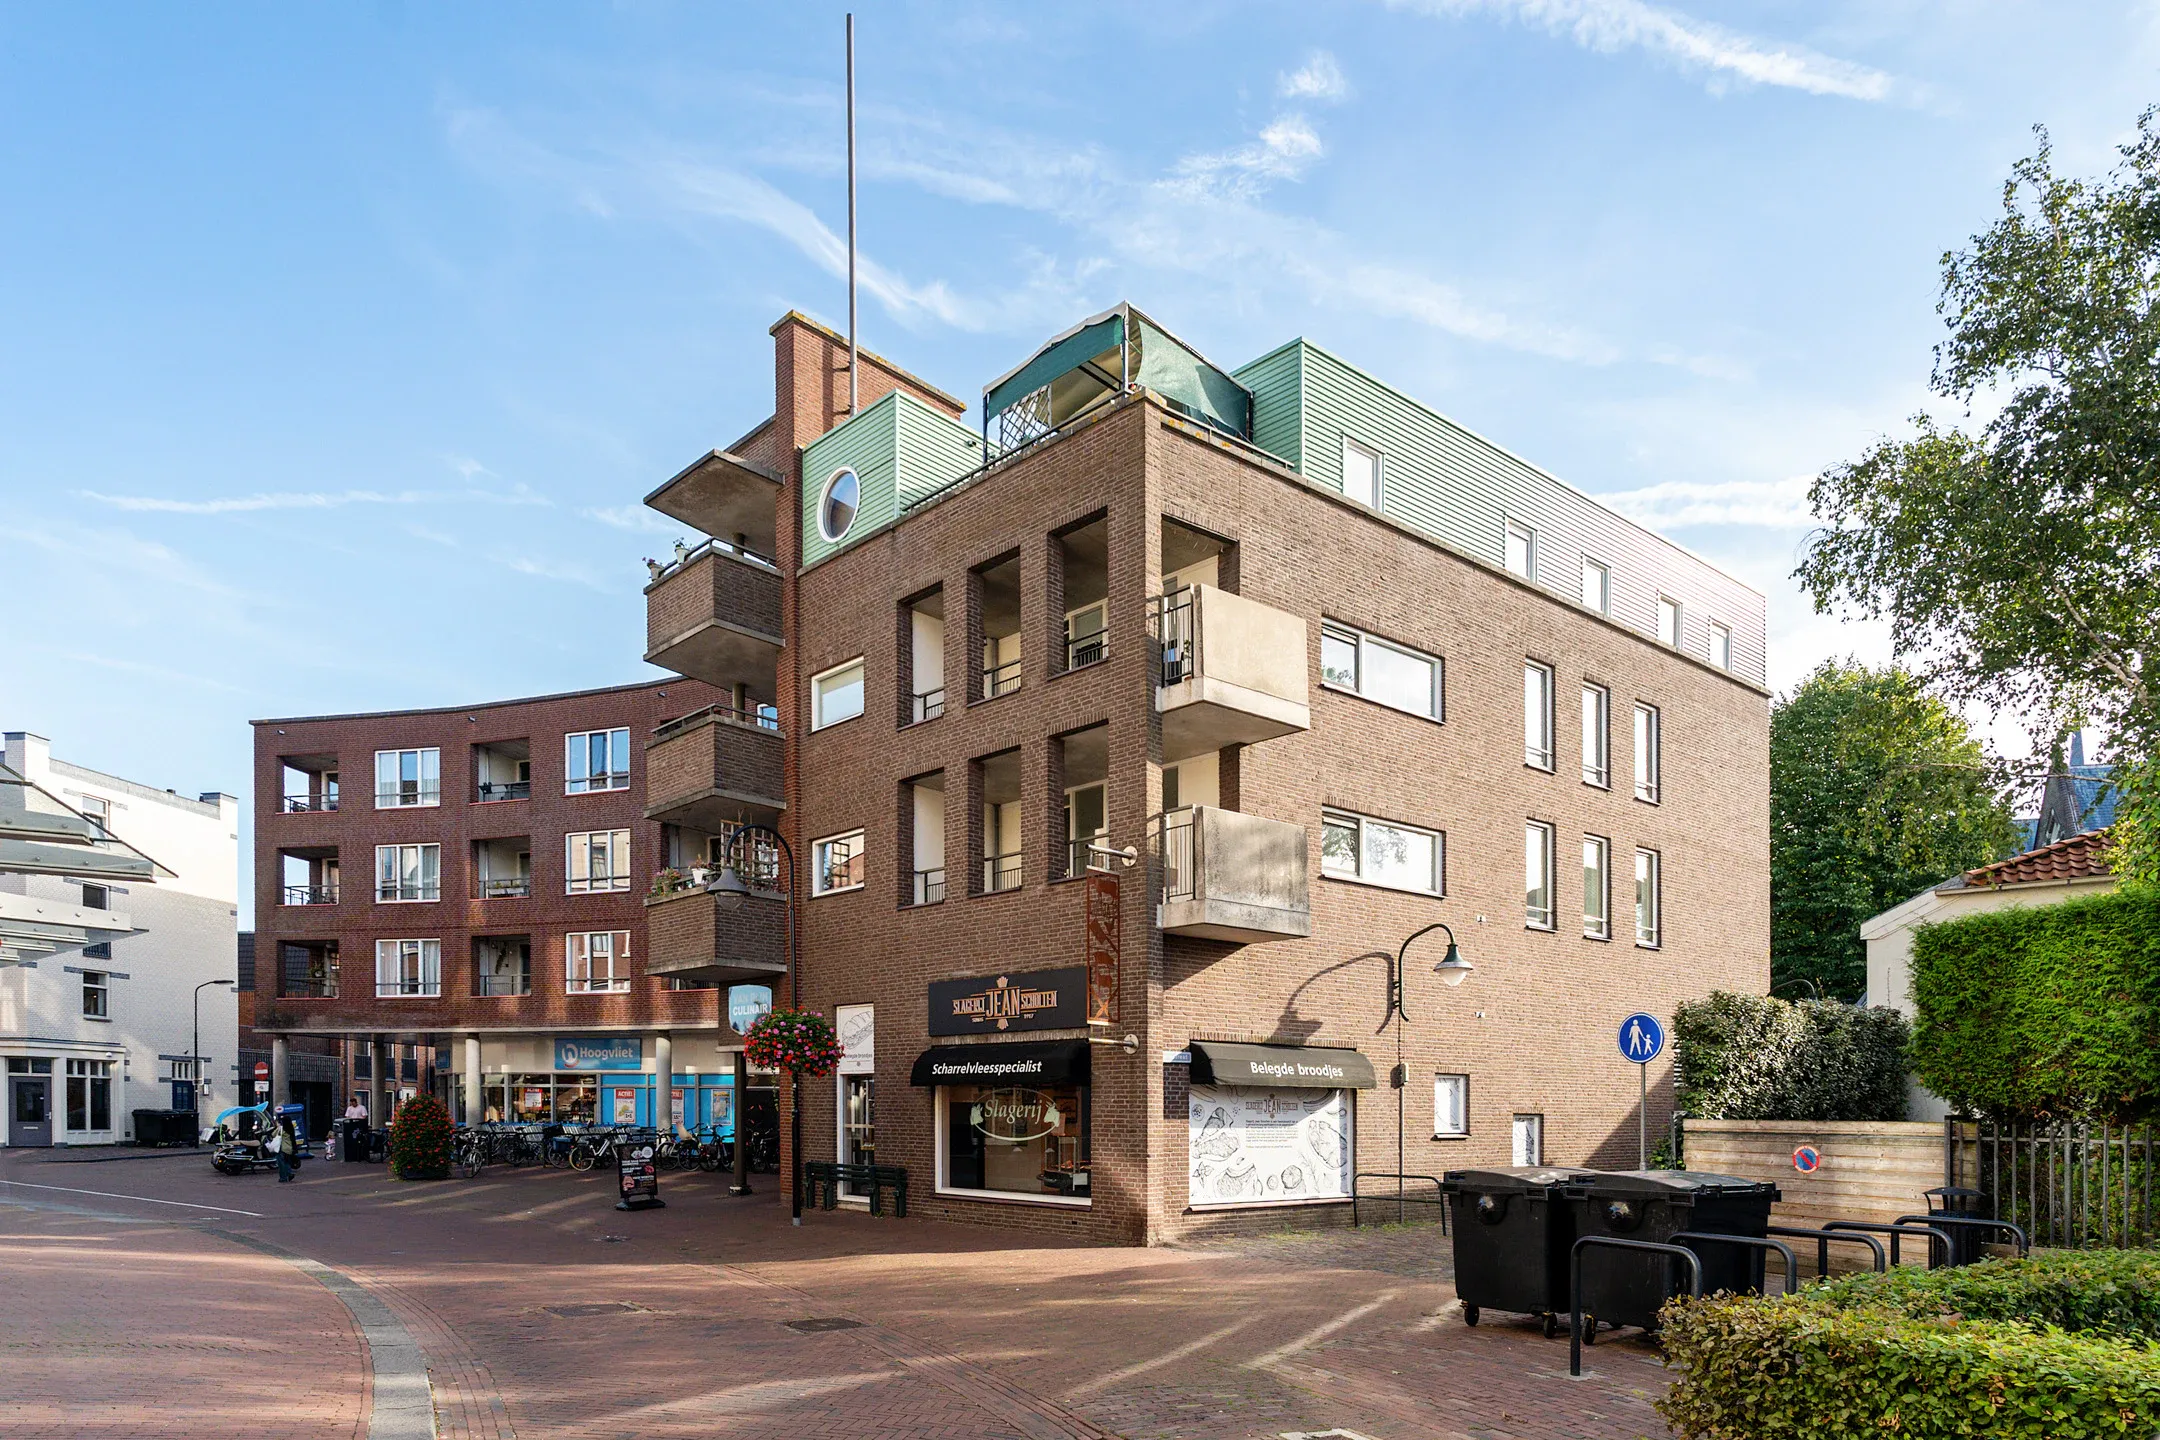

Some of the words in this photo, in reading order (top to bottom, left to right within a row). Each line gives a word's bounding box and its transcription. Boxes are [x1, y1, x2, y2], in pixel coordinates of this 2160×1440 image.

[732, 1003, 768, 1016] CULINAIR
[952, 997, 985, 1015] SLAGERIJ
[986, 989, 1020, 1017] JEAN
[1020, 990, 1058, 1010] SCHOLTEN
[580, 1046, 634, 1061] Hoogvliet
[932, 1060, 1042, 1076] Scharrelvleesspecialist
[1250, 1062, 1294, 1076] Belegde
[1297, 1063, 1343, 1079] broodjes
[984, 1099, 1042, 1124] Slagerij
[1263, 1099, 1281, 1113] JEAN
